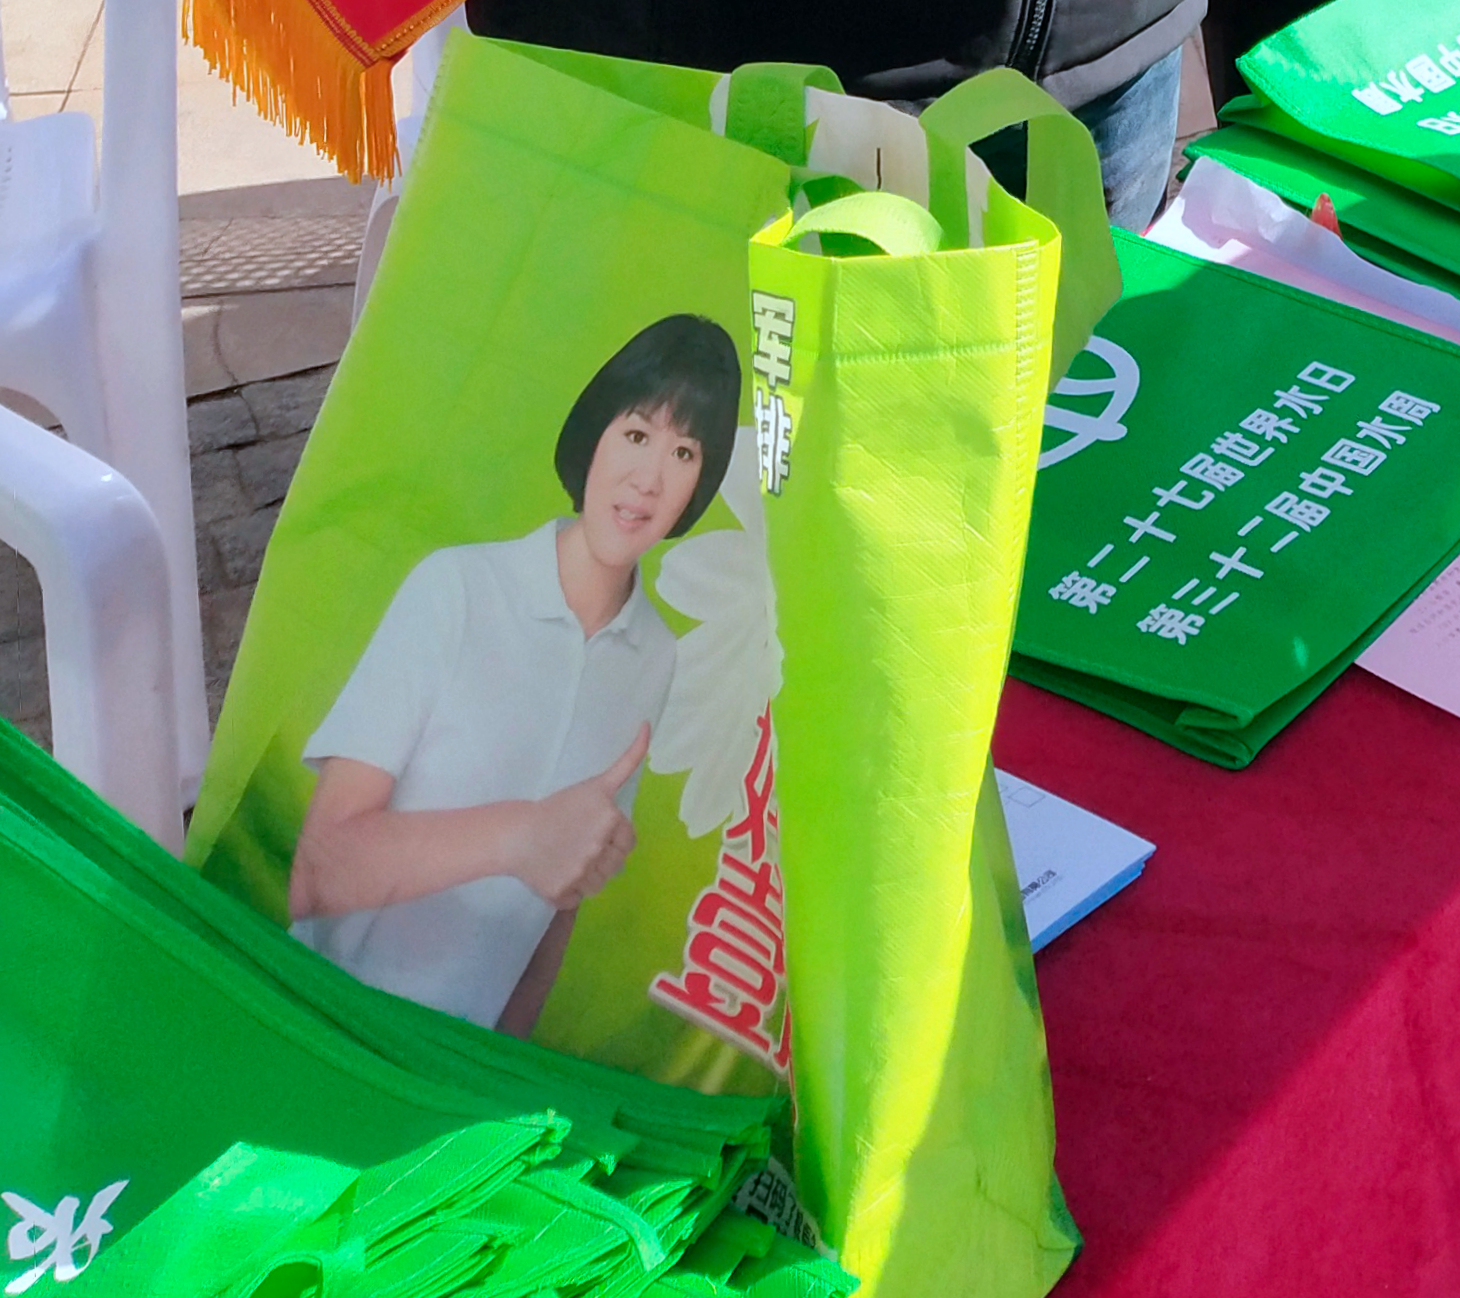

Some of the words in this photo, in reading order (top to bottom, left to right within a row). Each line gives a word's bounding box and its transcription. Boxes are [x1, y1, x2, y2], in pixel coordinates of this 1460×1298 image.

[1048, 361, 1356, 614] 第二十七届世界水日
[1135, 390, 1441, 646] 第三十二届中国水周
